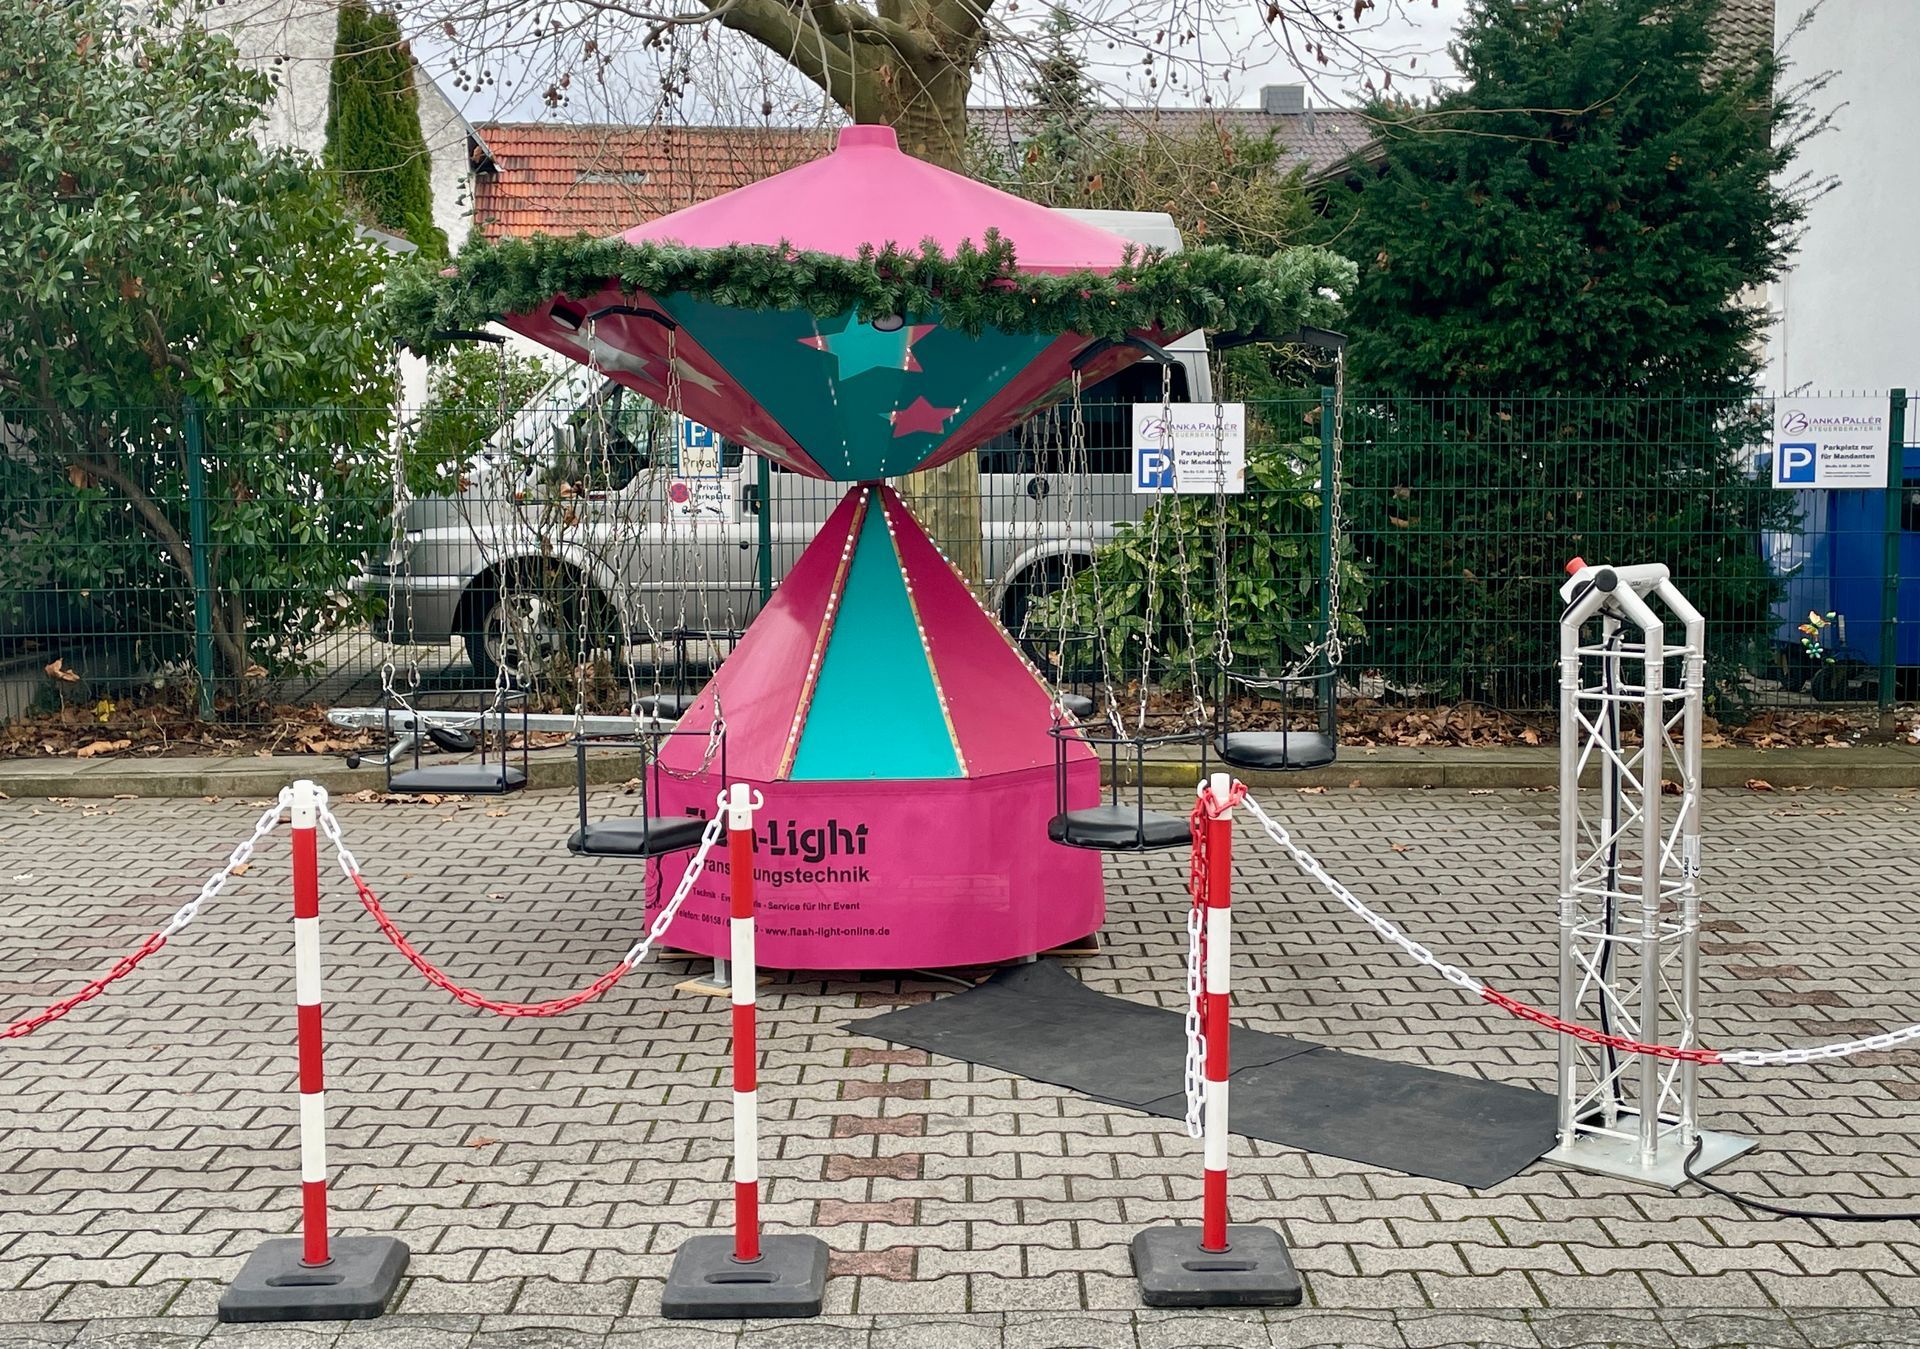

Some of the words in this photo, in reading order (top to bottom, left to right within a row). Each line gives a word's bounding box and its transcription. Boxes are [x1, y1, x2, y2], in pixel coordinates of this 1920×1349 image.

[1823, 444, 1859, 452] Parkplatz
[1142, 453, 1170, 484] P
[1783, 448, 1812, 479] P
[768, 901, 800, 911] Service
[803, 901, 816, 911] für
[818, 902, 832, 911] Ihr
[833, 902, 860, 910] Event
[765, 927, 890, 937] www.flash-light-online.de
